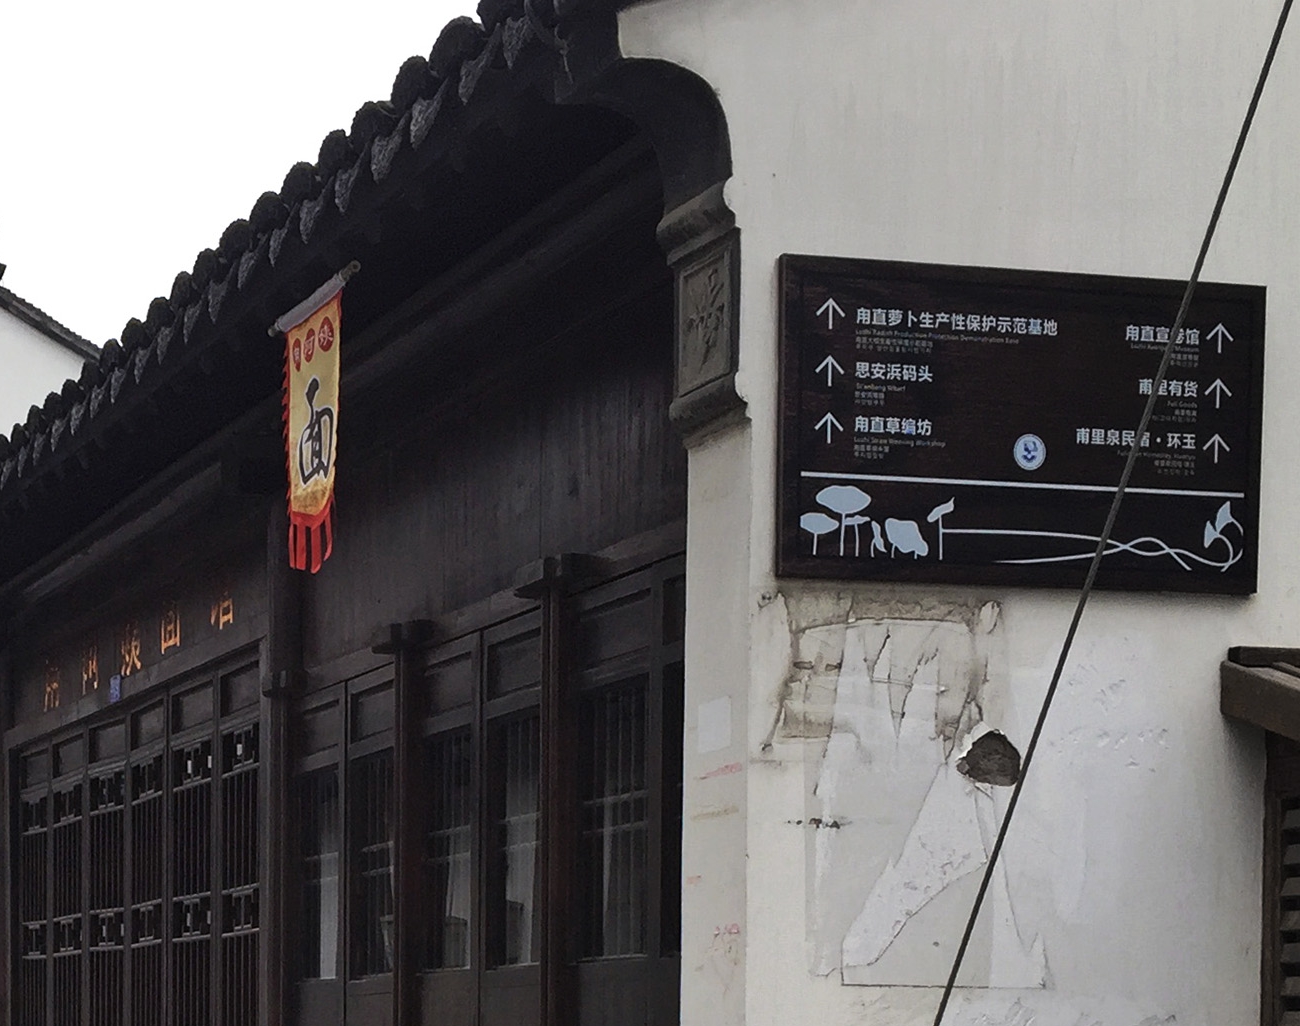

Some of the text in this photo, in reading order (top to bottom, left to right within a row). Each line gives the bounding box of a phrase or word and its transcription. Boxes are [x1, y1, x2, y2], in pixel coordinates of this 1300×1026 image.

[855, 361, 933, 382] 思安浜码头
[1138, 378, 1198, 398] 甫里有货
[854, 415, 932, 436] 甪直草编坊
